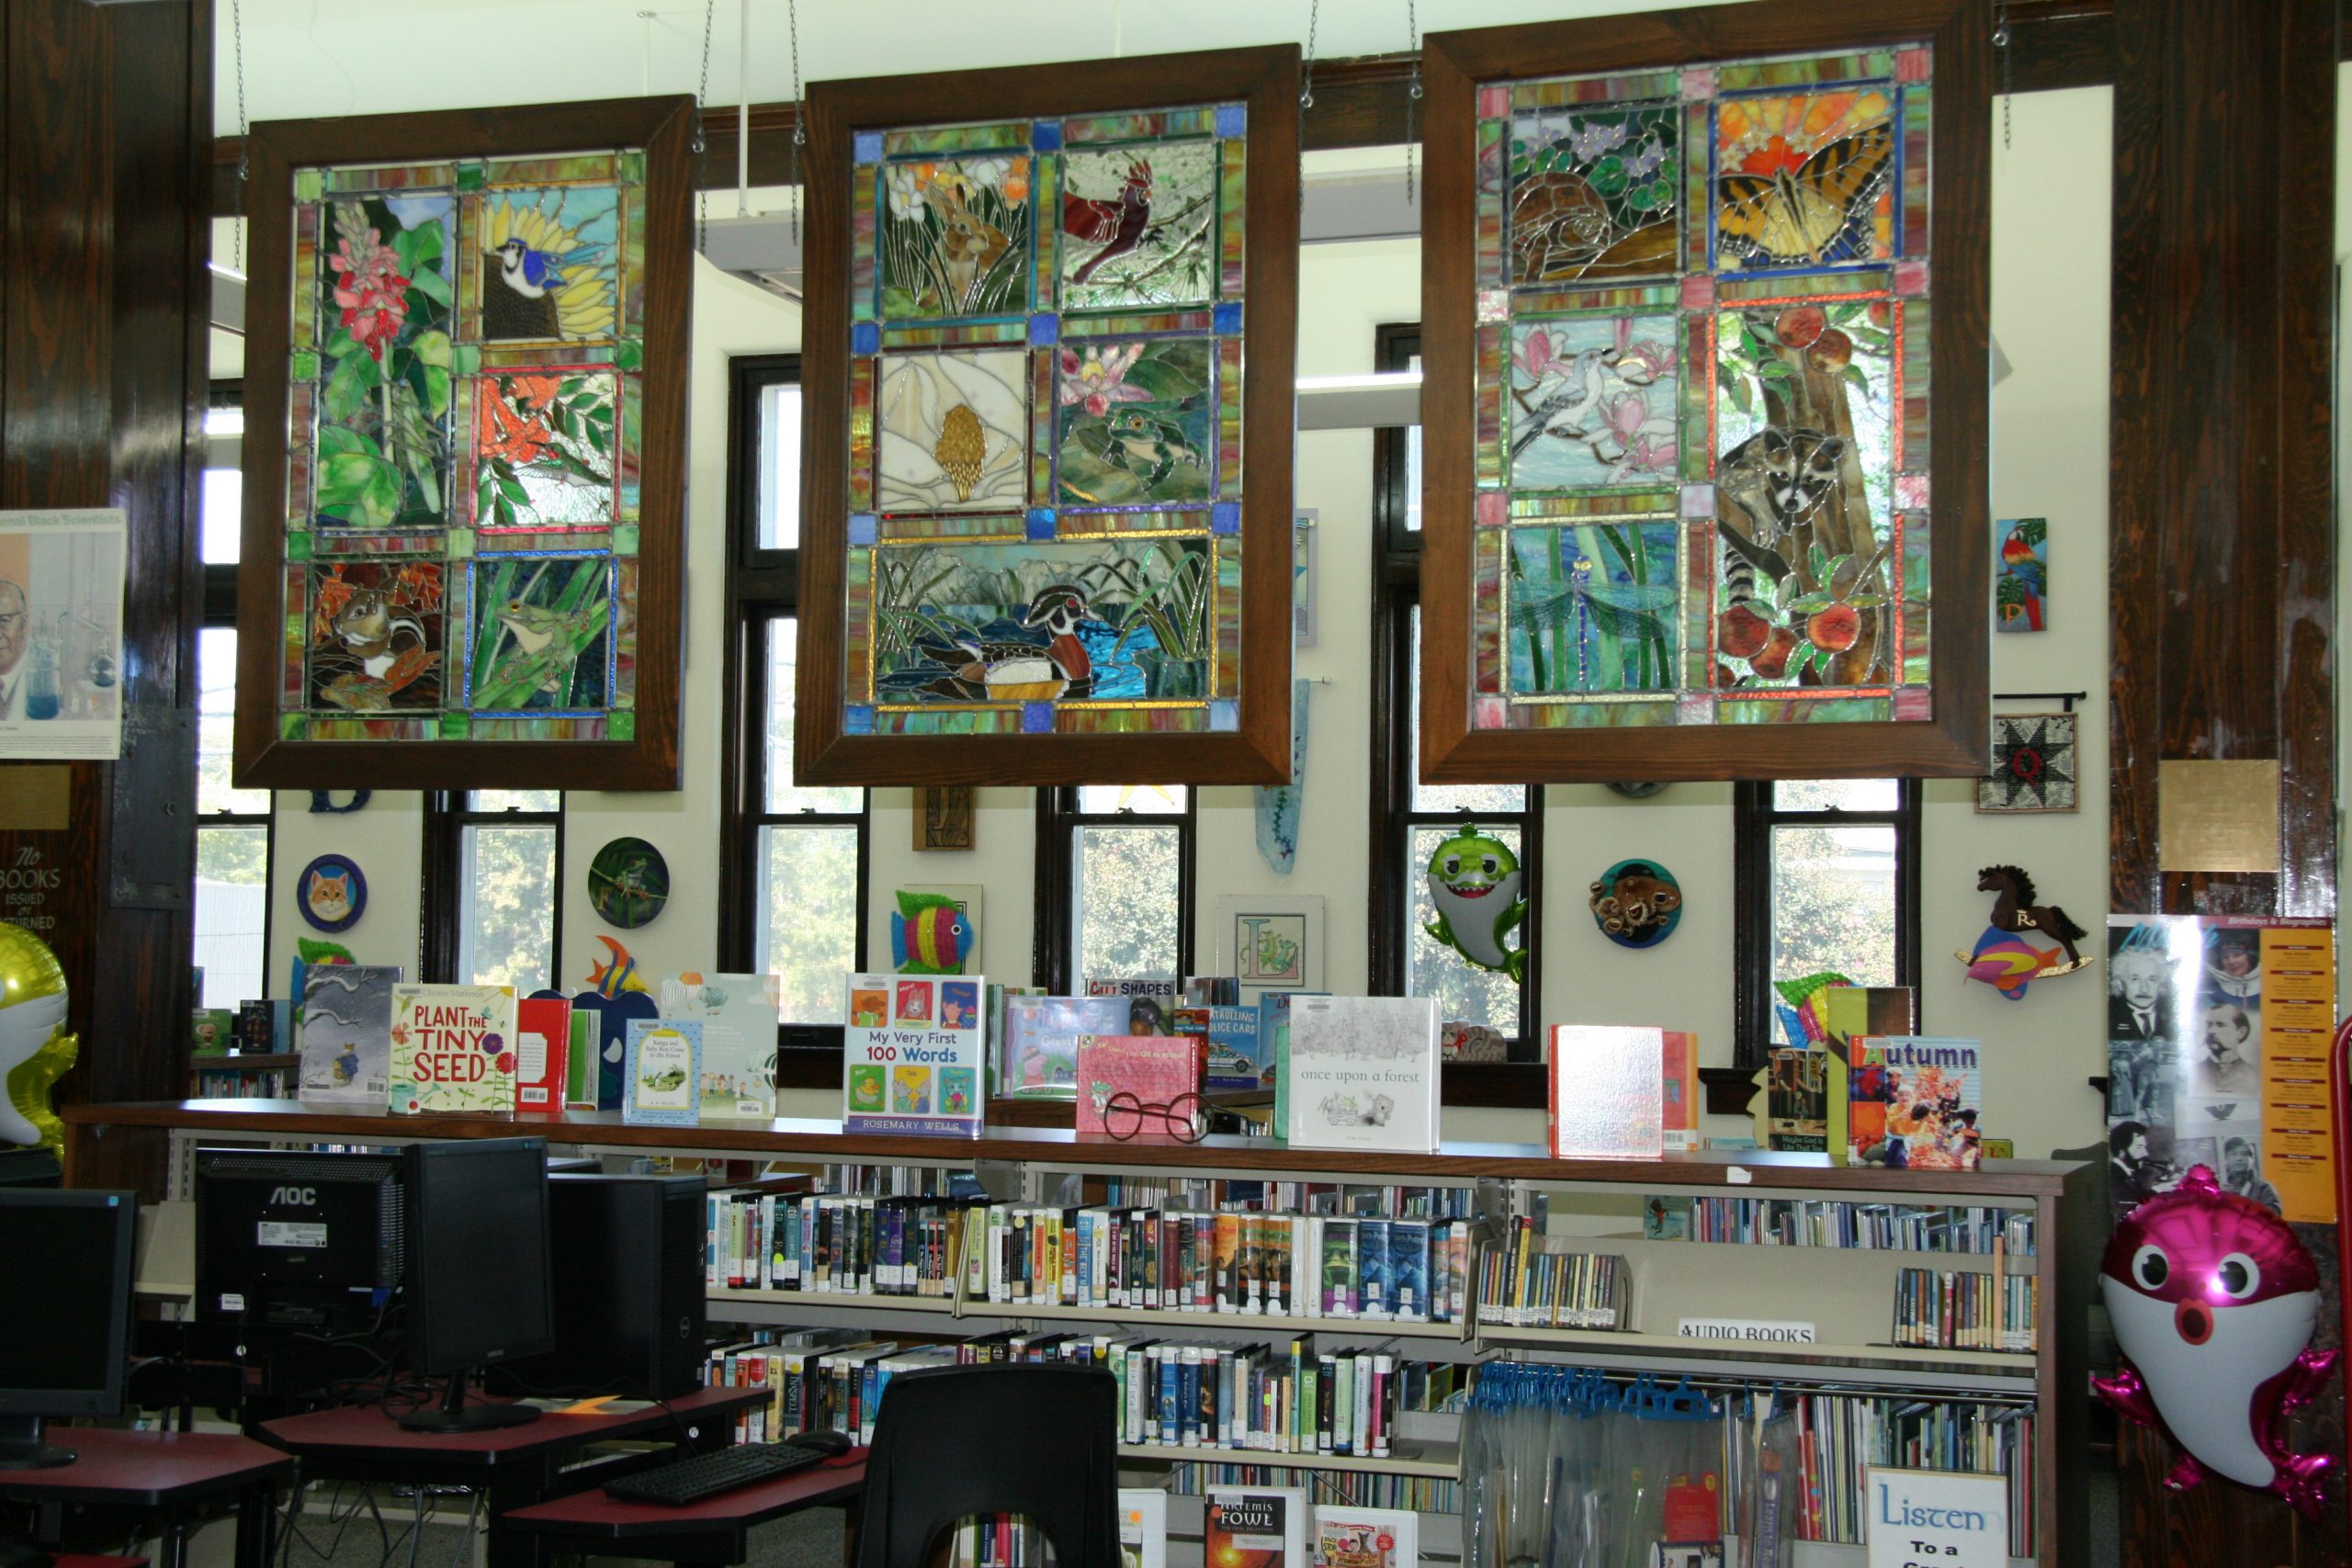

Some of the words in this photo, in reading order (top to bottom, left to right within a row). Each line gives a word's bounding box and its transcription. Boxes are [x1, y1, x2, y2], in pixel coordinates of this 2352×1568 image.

[28, 515, 60, 526] Black
[62, 514, 120, 525] Scientists
[1998, 603, 2024, 626] P
[2013, 749, 2042, 788] Q
[6, 893, 45, 905] ISSUED
[2228, 916, 2267, 927] Birthdays
[2270, 917, 2277, 925] &
[2279, 918, 2327, 928] Biographies
[1242, 919, 1298, 979] L
[899, 983, 916, 992] More!
[1121, 982, 1171, 996] SHAPES
[414, 1005, 469, 1028] PLANT
[468, 1016, 487, 1028] THE
[1209, 1010, 1254, 1023] ATROLLING
[1208, 1022, 1231, 1032] OLICE
[1233, 1024, 1256, 1034] CARS
[414, 1029, 486, 1051] TINY
[869, 1032, 889, 1044] My
[894, 1032, 923, 1045] Very
[928, 1032, 956, 1044] First
[867, 1046, 897, 1061] 100
[902, 1047, 957, 1063] Words
[1863, 1043, 1977, 1068] Autumn
[413, 1052, 486, 1082] SEED
[1301, 1070, 1331, 1080] once
[1336, 1071, 1367, 1084] upon
[1372, 1073, 1380, 1082] a
[1385, 1069, 1419, 1083] forest
[864, 1120, 919, 1130] ROSEMARY
[924, 1122, 959, 1131] WELLS
[1782, 1136, 1802, 1145] Maybe
[270, 1187, 316, 1205] AOC
[1680, 1325, 1739, 1339] AUDIO
[1746, 1327, 1812, 1343] BOOKS
[787, 1375, 799, 1414] INKSPELL
[1221, 1501, 1273, 1512] ARTEMIS
[1878, 1483, 1984, 1531] Listen
[1221, 1511, 1273, 1526] FOWL
[1323, 1543, 1338, 1551] STOP
[1910, 1540, 1938, 1554] To
[1945, 1546, 1958, 1556] a
